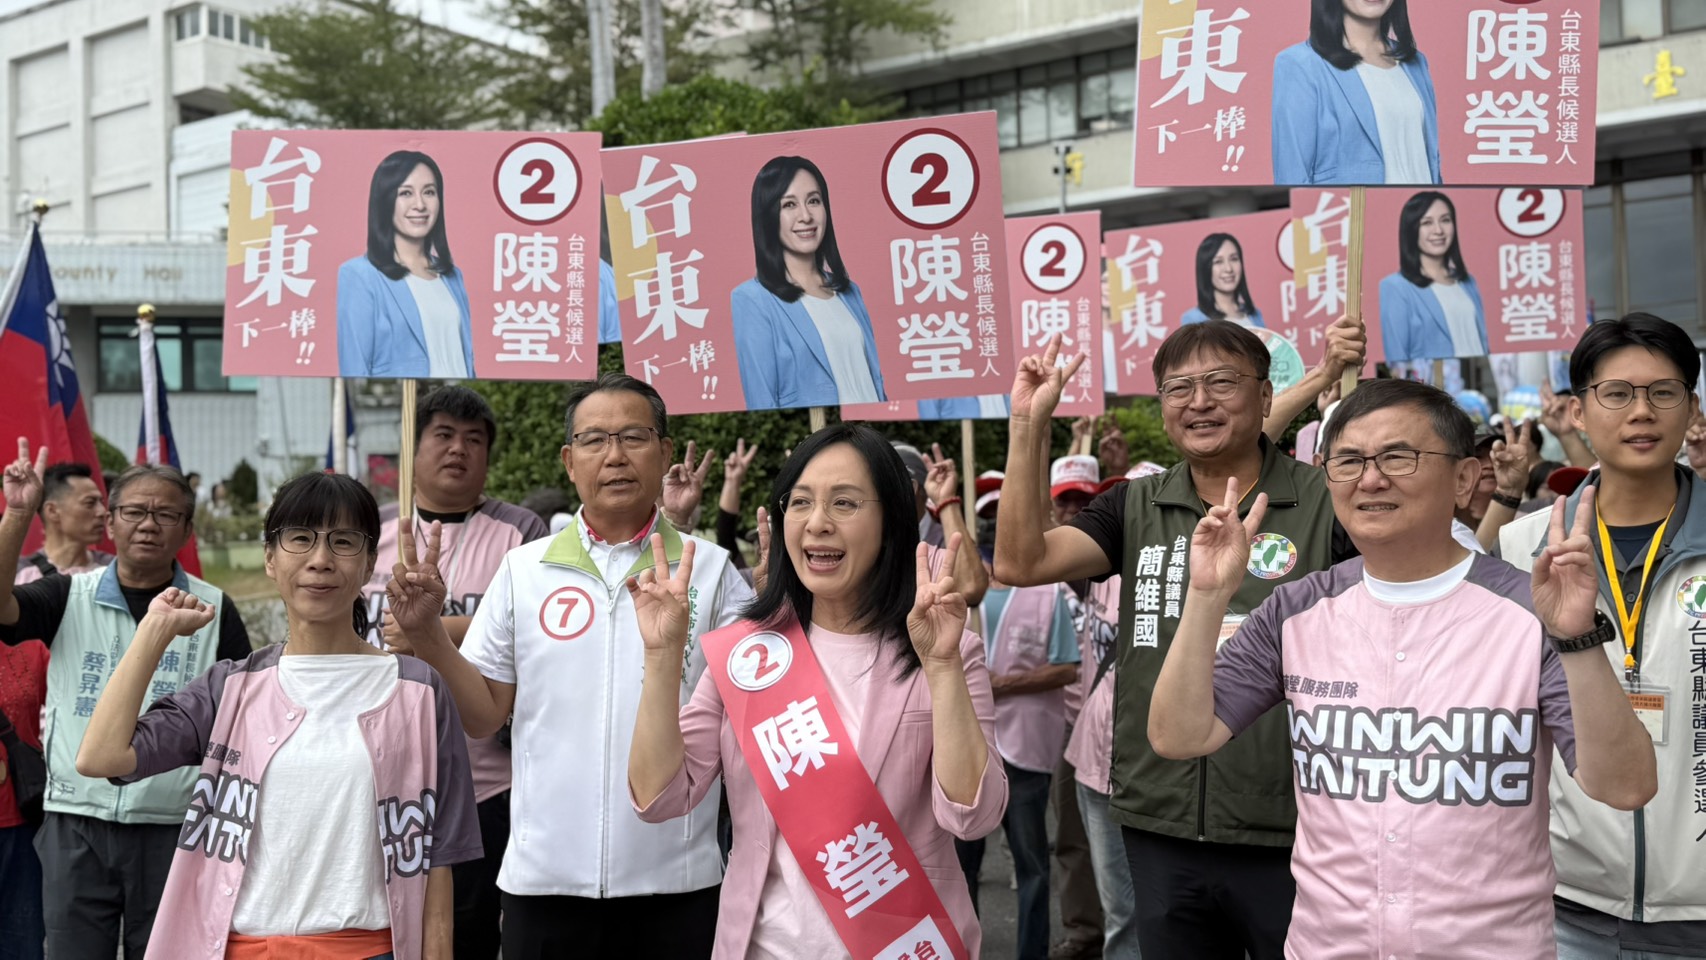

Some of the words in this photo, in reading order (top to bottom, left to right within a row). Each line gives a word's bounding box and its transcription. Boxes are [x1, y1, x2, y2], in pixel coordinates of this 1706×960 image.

[1150, 0, 1250, 108] 東
[1464, 8, 1551, 164] 陳瑩
[1555, 9, 1582, 165] 台東縣長候選人
[910, 153, 951, 207] 2
[1148, 106, 1246, 154] 下一棒
[235, 136, 321, 308] 台東
[520, 158, 555, 204] 2
[1516, 188, 1545, 223] 2
[54, 265, 118, 283] ounty
[492, 232, 562, 363] 陳瑩
[565, 233, 586, 364] 台東縣長候選人
[619, 155, 709, 345] 台東
[1039, 240, 1067, 277] 2
[1115, 234, 1168, 350] 台東
[1499, 241, 1557, 342] 陳瑩
[1558, 239, 1576, 339] 台東縣長候選人
[234, 308, 316, 348] 下一棒
[889, 234, 975, 382] 陳瑩
[970, 231, 1000, 378] 台東縣長候選人
[634, 340, 716, 385] 下一棒
[557, 597, 579, 629] 7
[1133, 544, 1167, 648] 簡維國
[1164, 535, 1188, 619] 台東縣議員
[742, 643, 780, 681] 2
[1286, 708, 1535, 755] WINWIN
[1292, 747, 1531, 802] TAITUNG
[751, 695, 910, 919] 陳瑩
